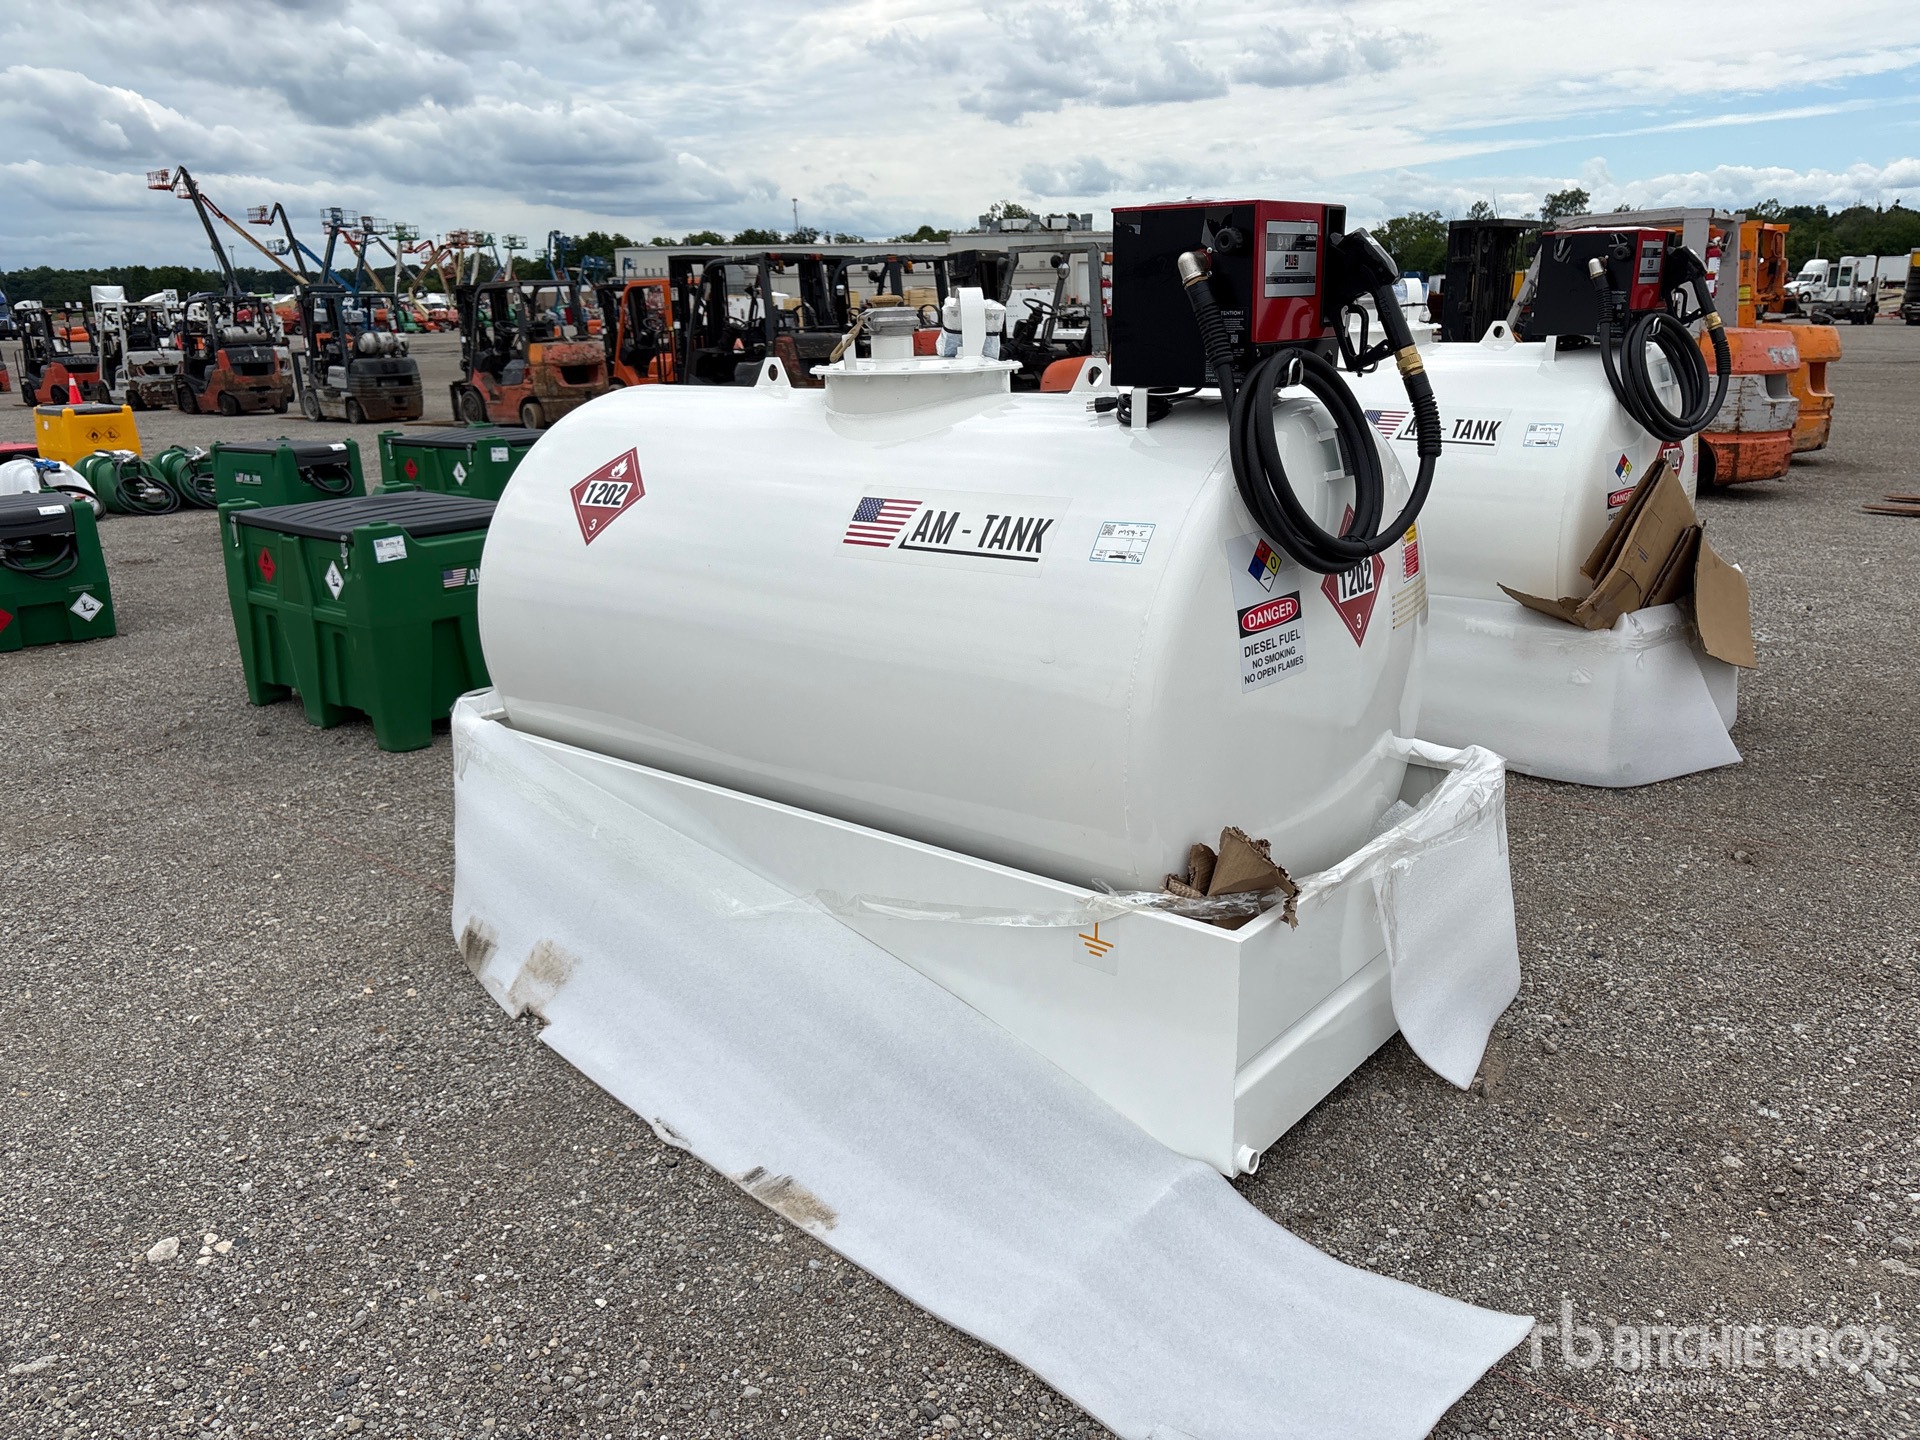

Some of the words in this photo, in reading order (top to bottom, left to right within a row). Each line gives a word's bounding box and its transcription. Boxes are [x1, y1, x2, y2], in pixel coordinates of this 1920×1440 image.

[1452, 418, 1503, 441] TANK
[585, 482, 629, 506] 1202
[1611, 491, 1632, 505] DANGE
[588, 518, 598, 531] 3
[911, 509, 961, 545] AM
[977, 514, 1055, 554] TANK
[1339, 559, 1373, 599] 1202
[1247, 601, 1293, 628] DANGER
[1356, 613, 1362, 629] 3
[1244, 637, 1278, 658] DIESEL
[1279, 628, 1301, 646] FUEL
[1244, 673, 1256, 685] NO
[1256, 665, 1277, 681] OPEN
[1277, 655, 1304, 673] FLAMES
[1252, 657, 1264, 670] NO
[1264, 645, 1296, 665] SMOKING
